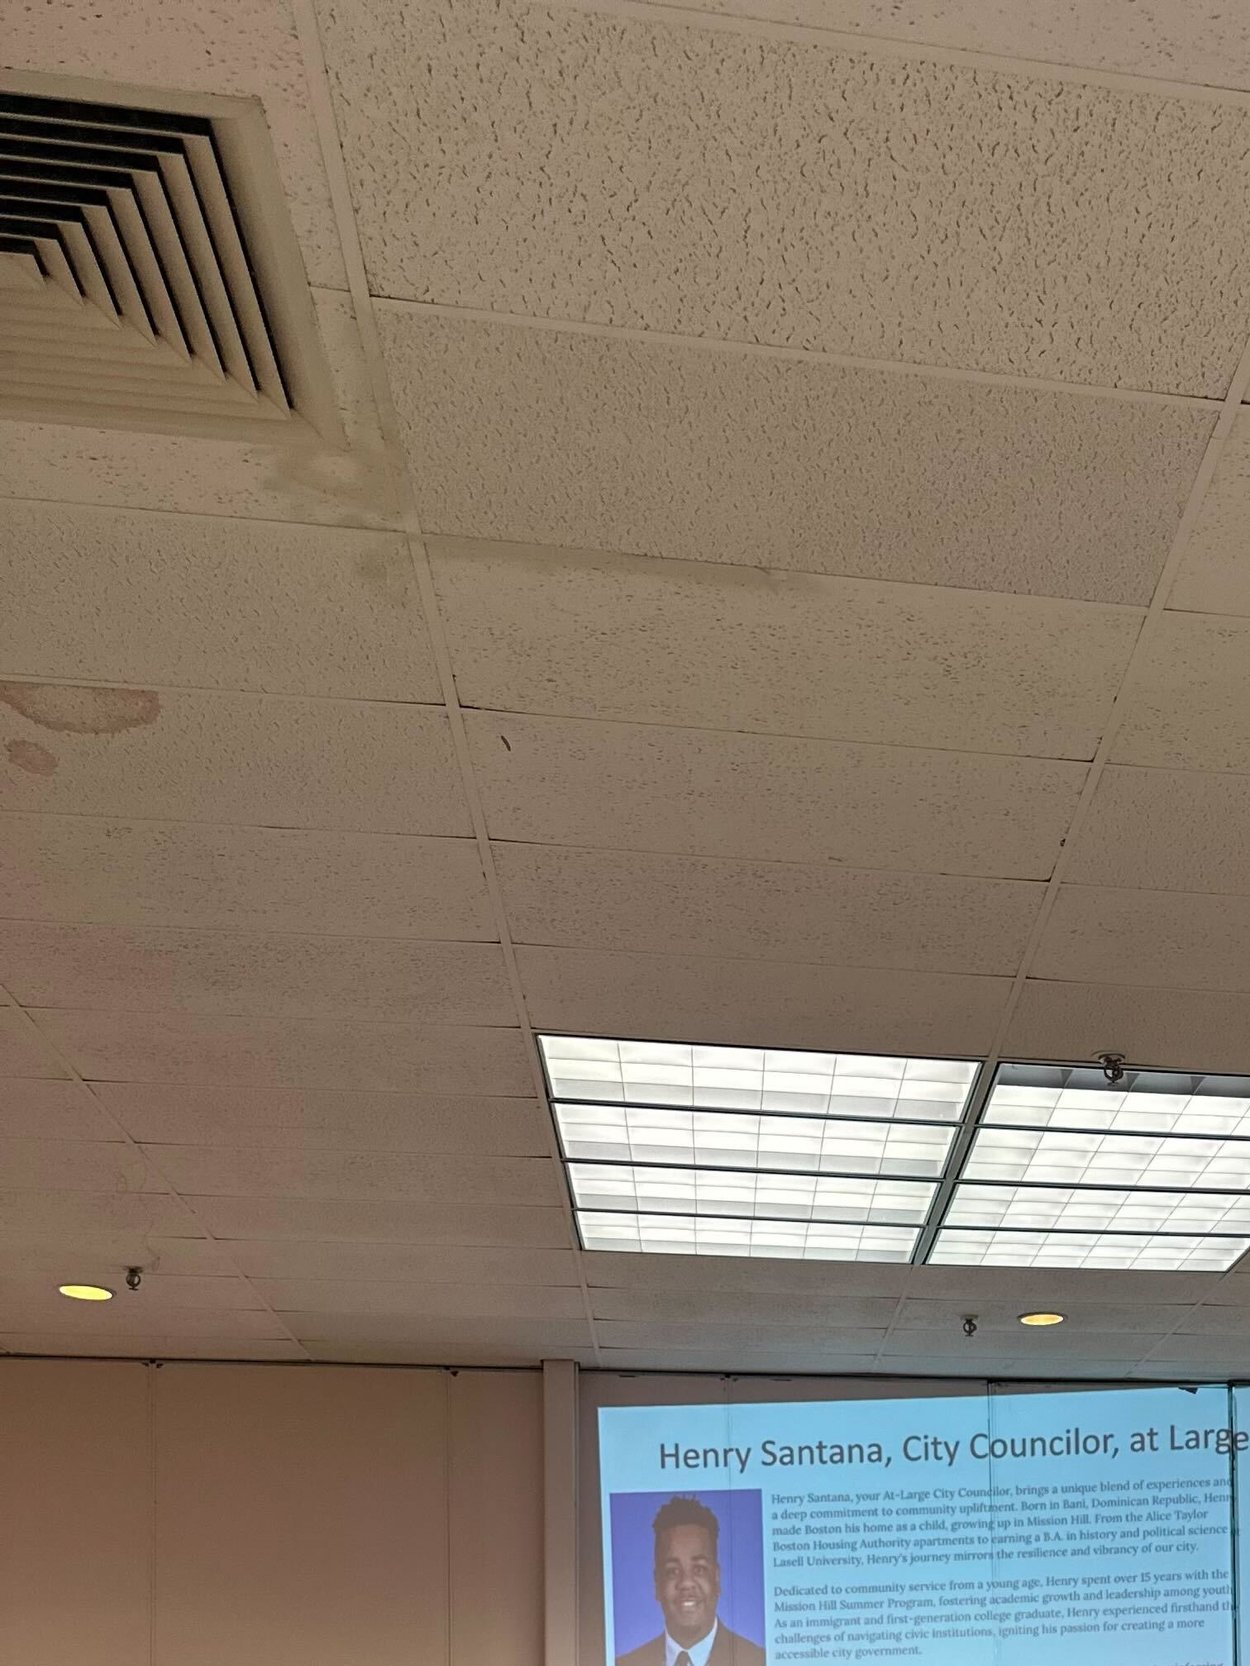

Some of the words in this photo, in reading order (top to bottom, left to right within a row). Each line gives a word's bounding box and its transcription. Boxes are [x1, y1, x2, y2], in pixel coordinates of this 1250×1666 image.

[660, 1442, 751, 1474] Henry
[761, 1440, 892, 1468] Santana,
[902, 1435, 960, 1466] City
[970, 1427, 1120, 1459] Councilor,
[1130, 1427, 1159, 1452] at
[1169, 1424, 1250, 1455] Large
[772, 1495, 805, 1506] Henry
[855, 1493, 880, 1504] your
[882, 1490, 930, 1502] At-Large
[933, 1488, 955, 1501] City
[1015, 1485, 1049, 1497] brings
[1060, 1483, 1097, 1495] unique
[1099, 1480, 1130, 1491] blend
[1133, 1479, 1144, 1490] of
[1146, 1478, 1210, 1491] experiences
[781, 1509, 807, 1522] deep
[810, 1507, 879, 1518] commitment
[881, 1507, 893, 1516] to
[895, 1504, 956, 1516] community
[1020, 1501, 1046, 1510] Born
[1049, 1500, 1059, 1509] in
[1091, 1496, 1149, 1507] Dominican
[1203, 1493, 1237, 1505] Henr
[772, 1525, 802, 1536] made
[804, 1525, 842, 1534] Boston
[844, 1523, 860, 1533] his
[862, 1522, 893, 1532] home
[950, 1518, 994, 1532] growing
[996, 1520, 1010, 1530] up
[1013, 1517, 1024, 1527] in
[1026, 1516, 1068, 1526] Mission
[1094, 1513, 1123, 1522] From
[1125, 1511, 1143, 1521] the
[1145, 1510, 1171, 1521] Alice
[1174, 1509, 1208, 1522] Taylor
[773, 1542, 810, 1551] Boston
[813, 1539, 857, 1552] Housing
[859, 1537, 910, 1550] Authority
[913, 1536, 974, 1549] apartments
[976, 1535, 988, 1544] to
[990, 1533, 1032, 1545] earning
[1066, 1531, 1076, 1540] in
[1079, 1529, 1117, 1541] history
[1119, 1527, 1140, 1537] and
[1142, 1525, 1185, 1540] political
[1188, 1525, 1228, 1535] science
[773, 1556, 804, 1567] Lasell
[866, 1553, 907, 1566] Henry's
[908, 1552, 951, 1565] journey
[953, 1550, 993, 1560] mirrors
[996, 1549, 1014, 1559] the
[1016, 1547, 1068, 1558] resilience
[1070, 1545, 1091, 1556] and
[1092, 1544, 1139, 1556] vibrancy
[1141, 1542, 1153, 1552] of
[1155, 1544, 1174, 1552] our
[774, 1584, 828, 1596] Dedicated
[830, 1586, 842, 1594] to
[844, 1582, 906, 1595] community
[908, 1581, 946, 1591] service
[948, 1580, 974, 1590] from
[985, 1579, 1019, 1591] young
[1045, 1577, 1079, 1588] Henry
[1081, 1574, 1111, 1587] spent
[1114, 1575, 1138, 1583] over
[1140, 1571, 1151, 1582] 15
[1153, 1573, 1182, 1584] years
[1184, 1569, 1209, 1580] with
[1211, 1569, 1229, 1579] the
[774, 1601, 816, 1612] Mission
[818, 1600, 837, 1610] Hill
[839, 1600, 884, 1610] Summer
[938, 1595, 986, 1607] fostering
[988, 1593, 1039, 1604] academic
[1042, 1591, 1080, 1605] growth
[1083, 1589, 1103, 1599] and
[1105, 1587, 1161, 1600] leadership
[1163, 1587, 1200, 1598] among
[774, 1618, 788, 1628] As
[790, 1620, 803, 1628] an
[806, 1616, 861, 1629] immigrant
[863, 1614, 884, 1625] and
[886, 1612, 971, 1626] first-generation
[973, 1610, 1011, 1623] college
[1066, 1608, 1100, 1619] Henry
[1102, 1603, 1168, 1617] experienced
[1170, 1601, 1219, 1612] firsthand
[1221, 1600, 1239, 1610] th
[775, 1633, 831, 1645] challenges
[833, 1631, 845, 1642] of
[847, 1630, 902, 1643] navigating
[904, 1629, 929, 1639] civic
[998, 1625, 1039, 1638] igniting
[1041, 1624, 1057, 1634] his
[1059, 1623, 1100, 1636] passion
[1102, 1620, 1118, 1631] for
[1121, 1619, 1166, 1632] creating
[1176, 1620, 1205, 1628] more
[775, 1648, 829, 1659] accessible
[832, 1647, 852, 1660] city
